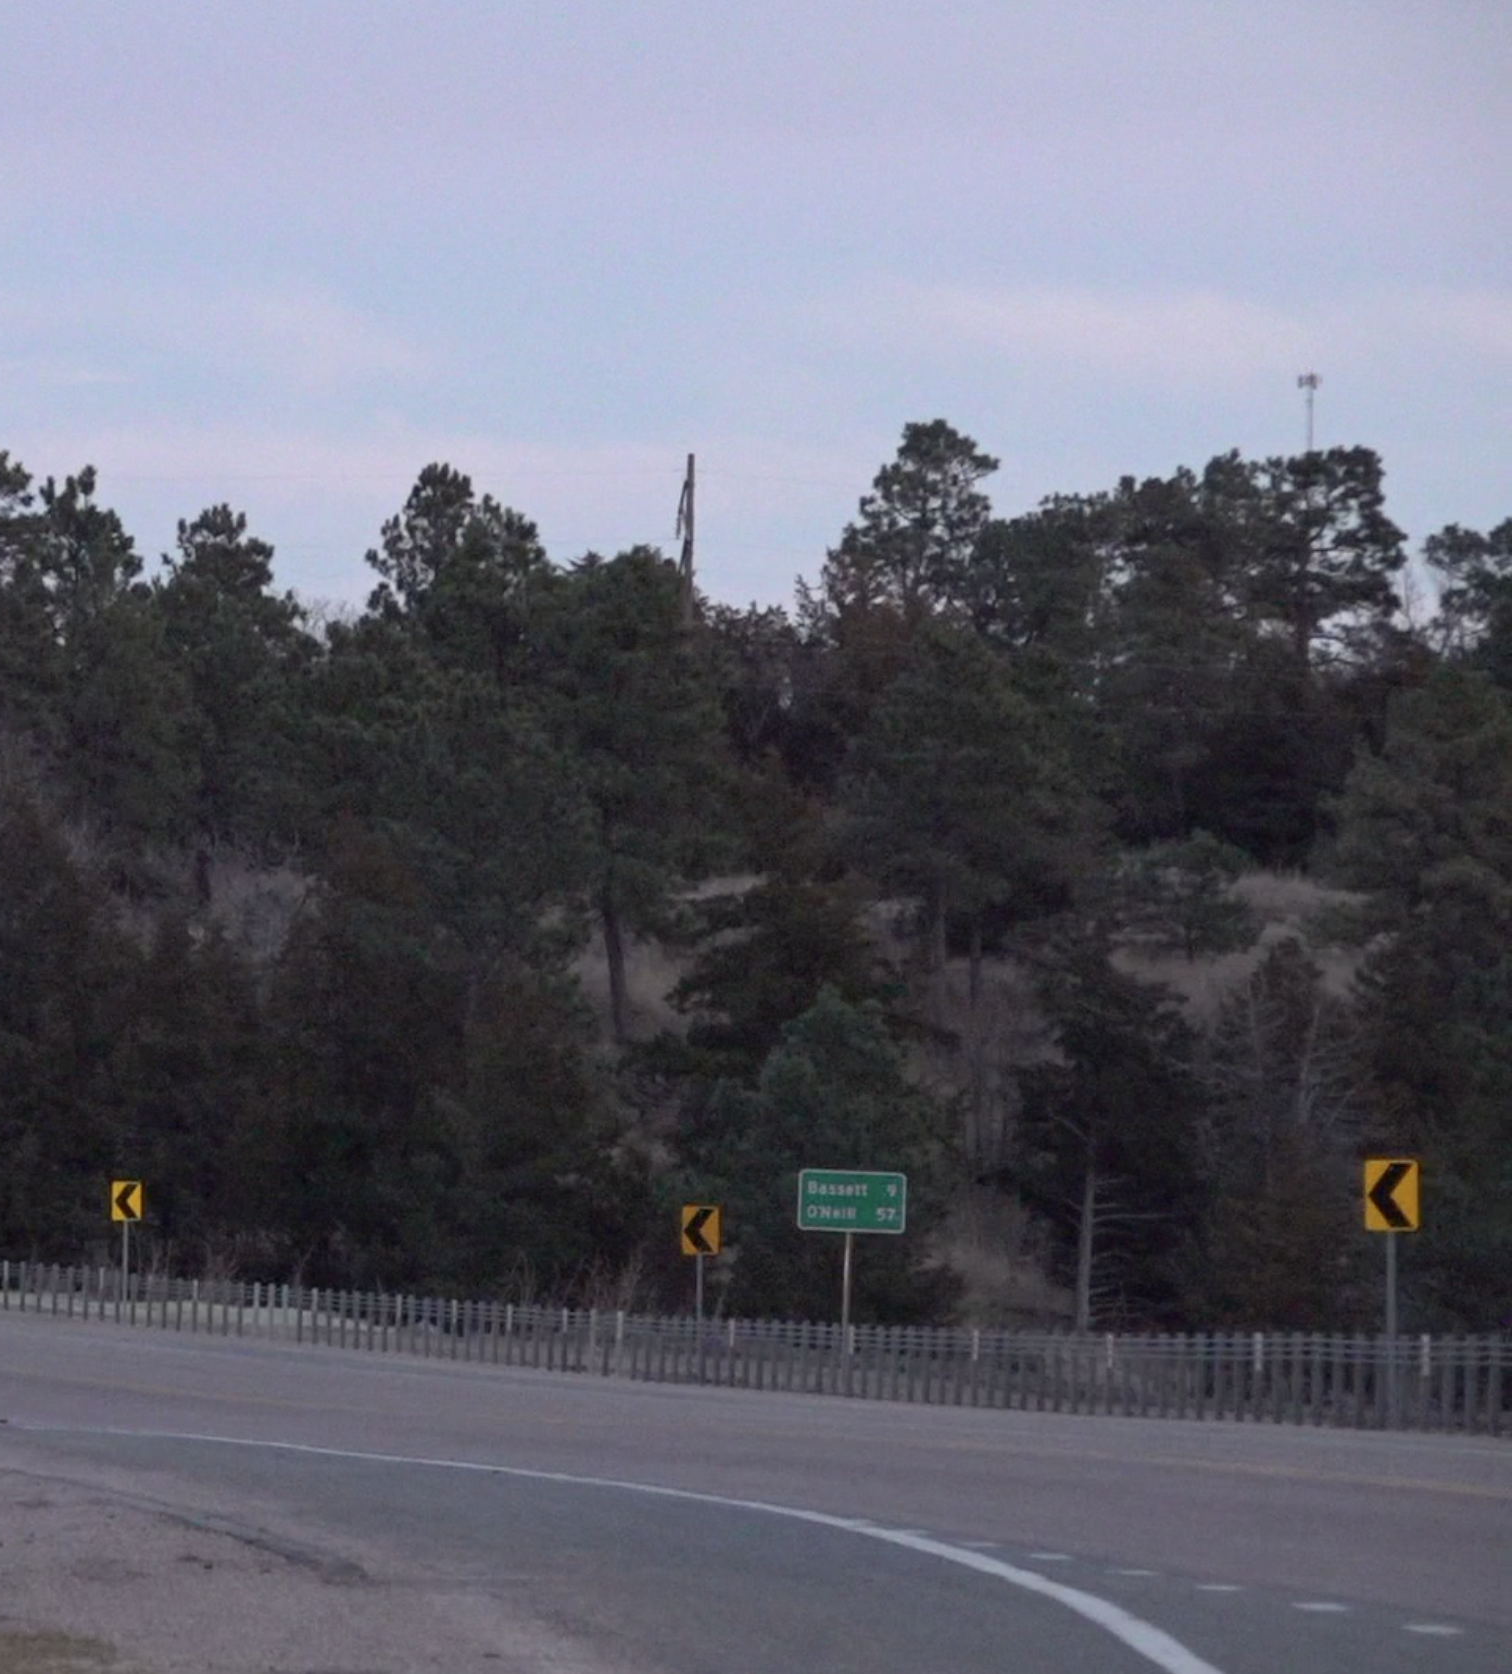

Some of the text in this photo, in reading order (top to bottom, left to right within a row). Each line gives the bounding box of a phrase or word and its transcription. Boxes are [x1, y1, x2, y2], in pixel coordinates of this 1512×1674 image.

[807, 1180, 897, 1197] Bassett 9
[876, 1207, 896, 1222] 57
